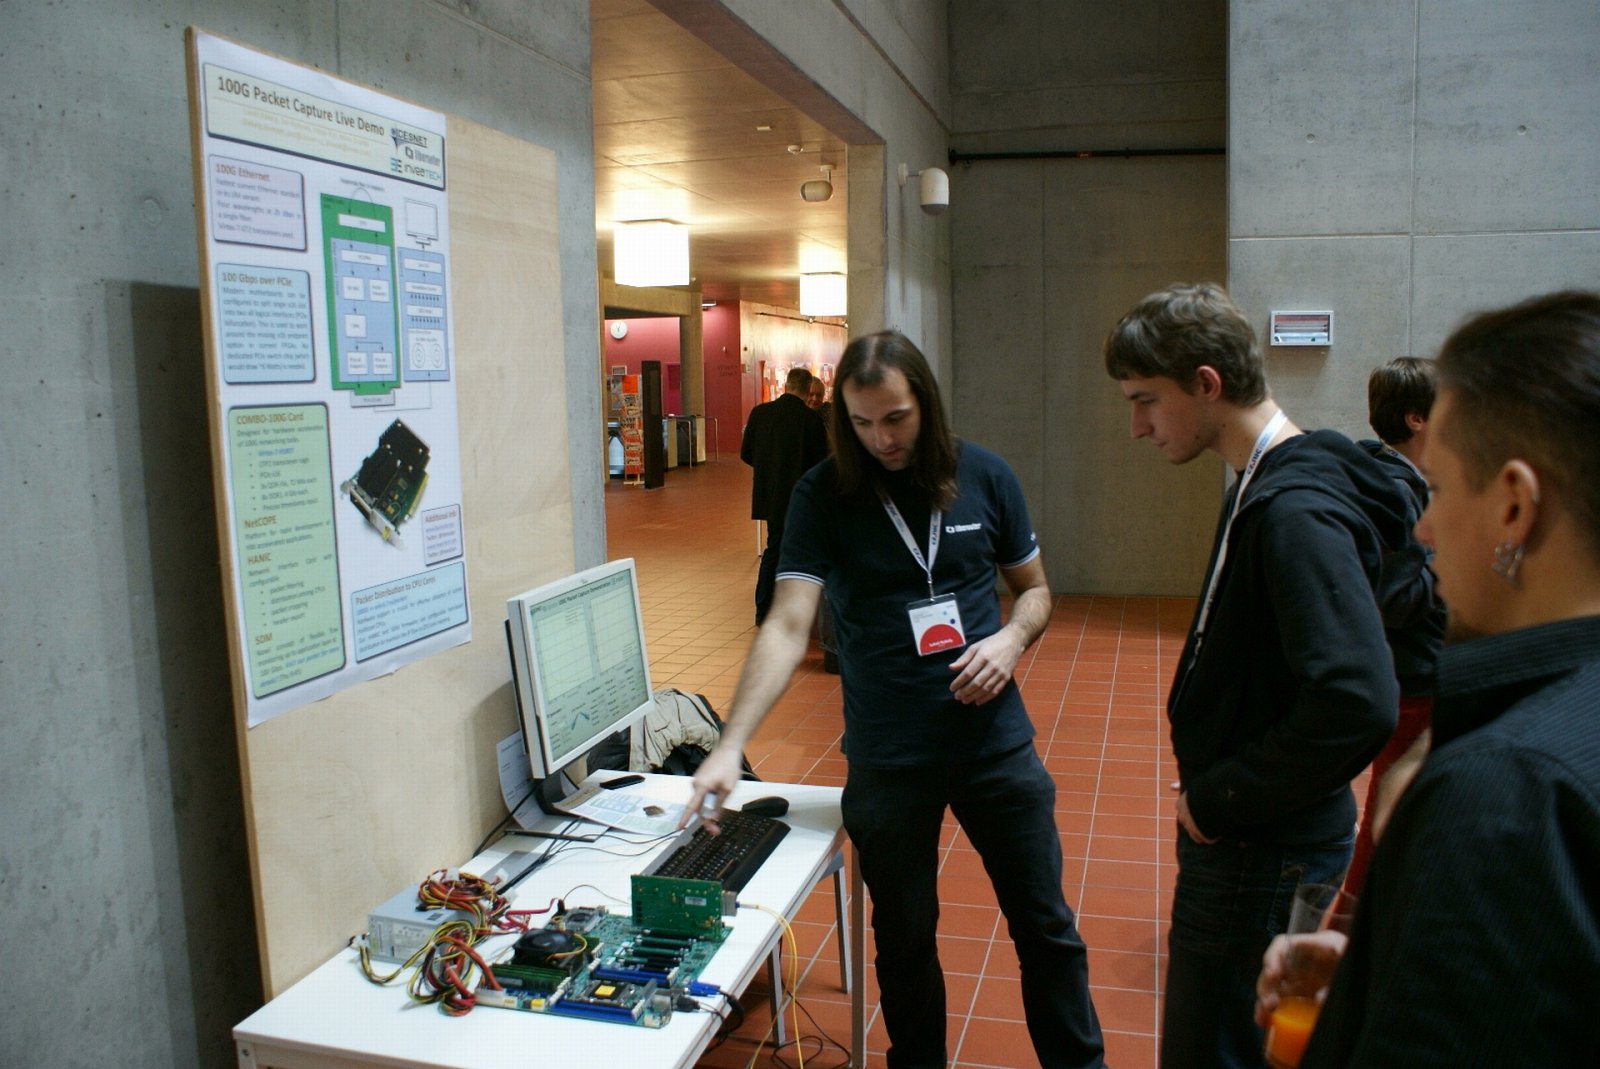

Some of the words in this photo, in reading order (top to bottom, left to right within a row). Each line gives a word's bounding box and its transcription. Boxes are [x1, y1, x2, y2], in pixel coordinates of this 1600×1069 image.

[218, 76, 250, 98] 100G
[254, 86, 290, 109] Packet
[294, 97, 333, 122] Capture
[336, 111, 355, 128] Live
[358, 117, 385, 136] Demo
[239, 167, 271, 182] Ethernet
[222, 273, 237, 283] 100
[239, 273, 258, 285] Gbps
[260, 277, 275, 285] over
